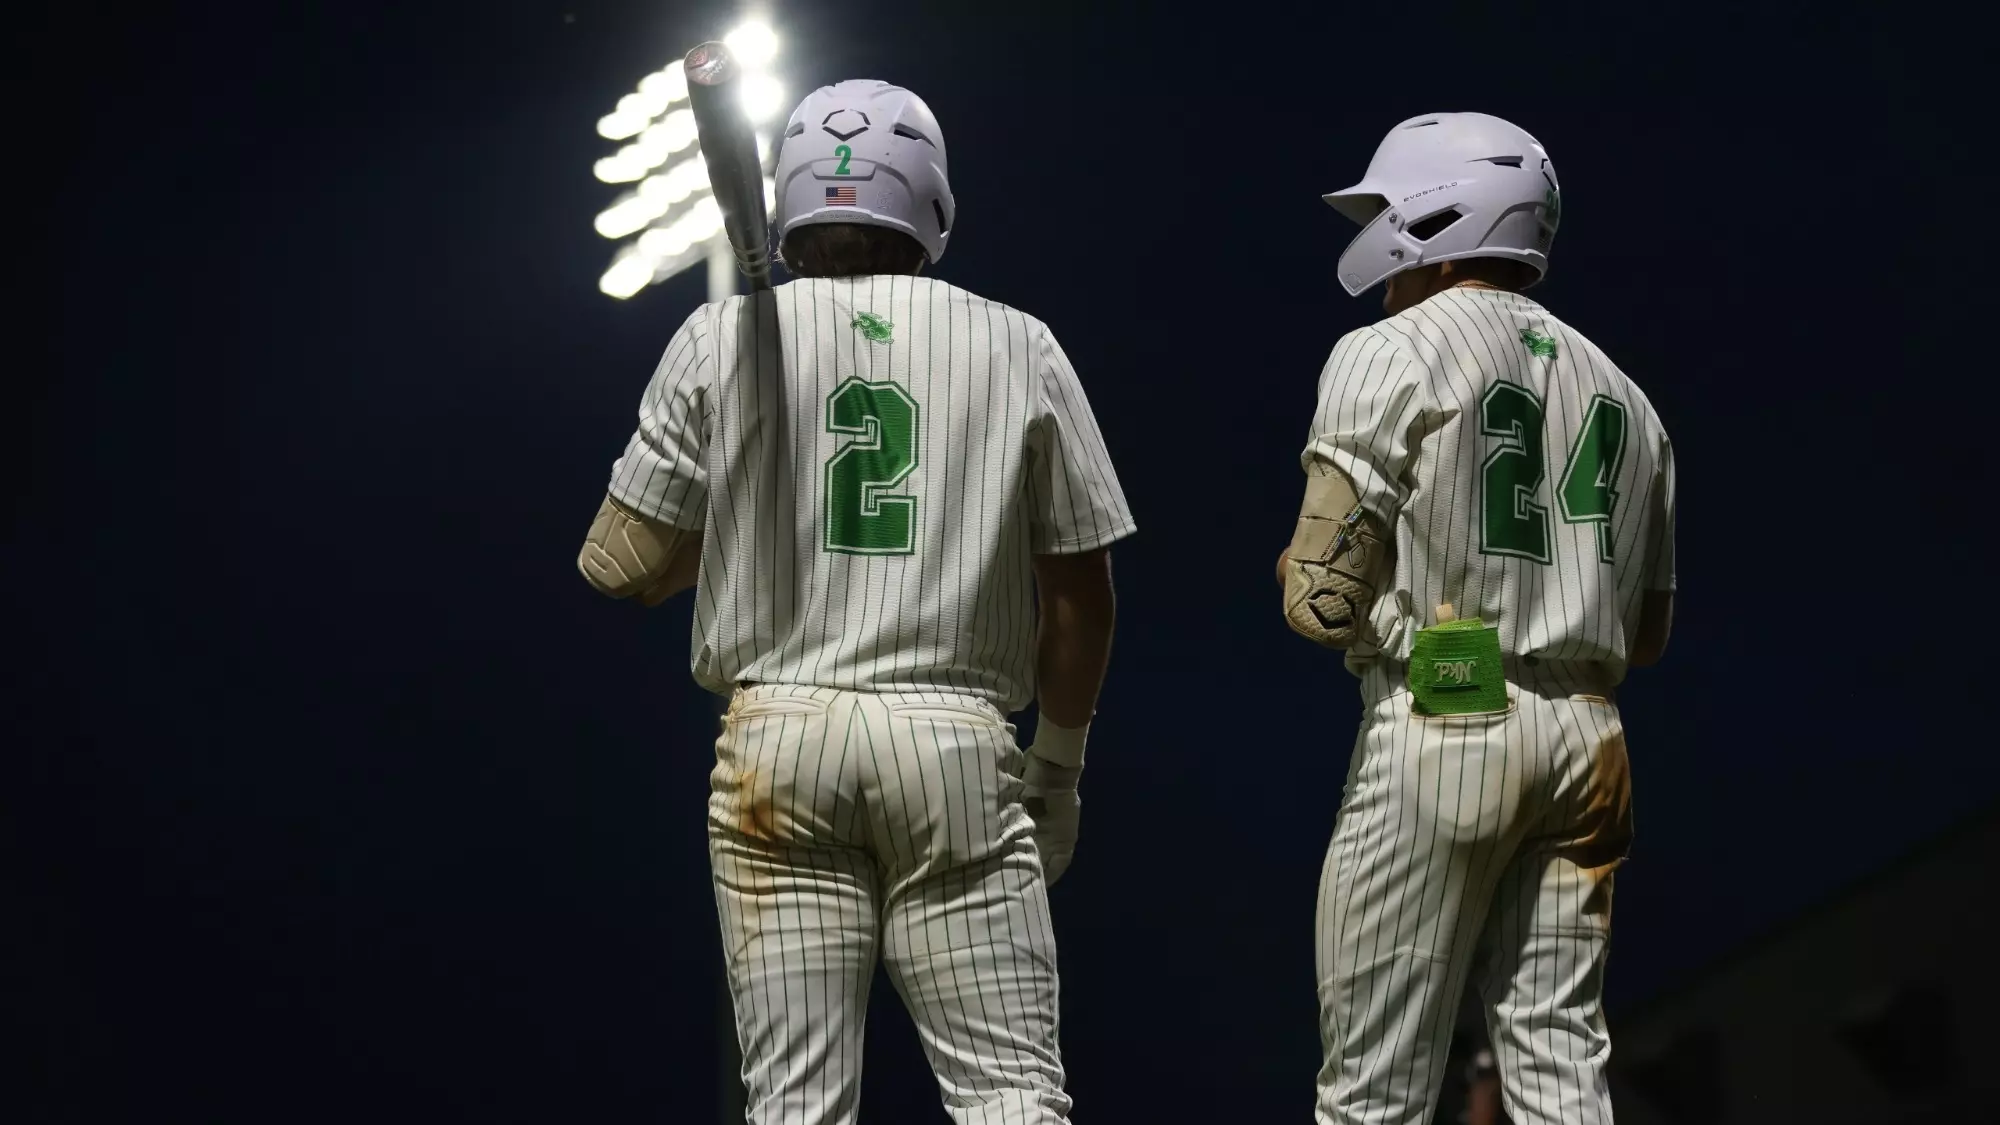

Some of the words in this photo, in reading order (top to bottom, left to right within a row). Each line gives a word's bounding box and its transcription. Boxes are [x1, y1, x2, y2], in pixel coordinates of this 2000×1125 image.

[835, 145, 852, 175] 2
[1403, 181, 1458, 203] EVOSHIELD
[824, 377, 919, 555] 2
[1479, 380, 1627, 565] 24
